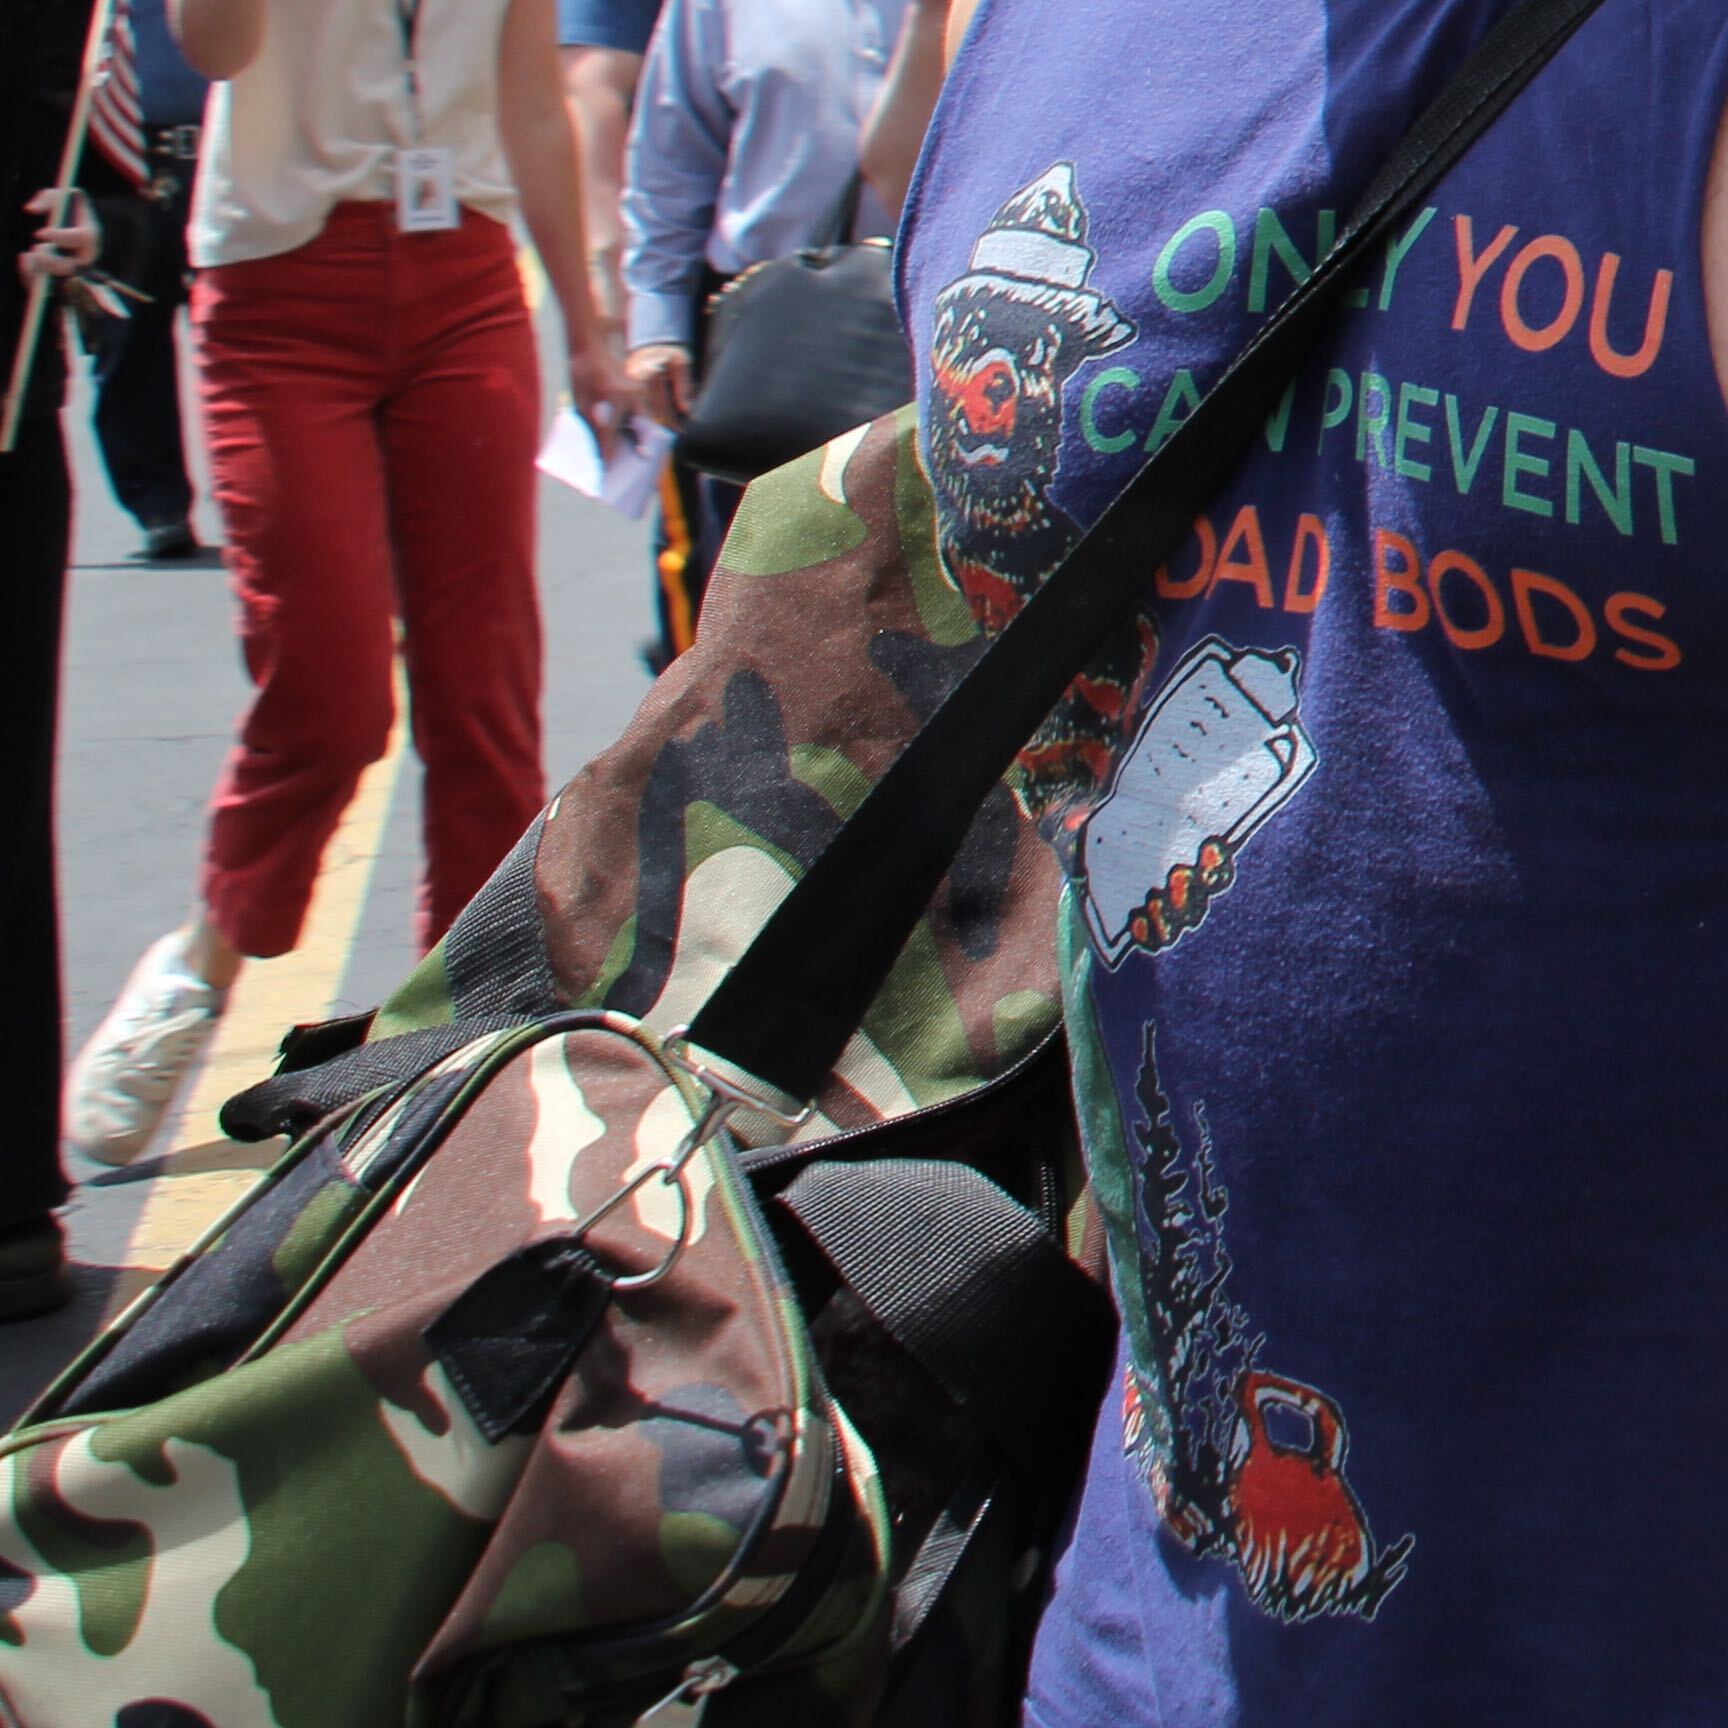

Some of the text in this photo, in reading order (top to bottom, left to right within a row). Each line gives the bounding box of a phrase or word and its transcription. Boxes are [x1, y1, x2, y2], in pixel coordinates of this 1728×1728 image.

[1153, 207, 1673, 378] ONY YOU
[1317, 368, 1695, 545] PREVENT
[1373, 530, 1682, 671] BODS
